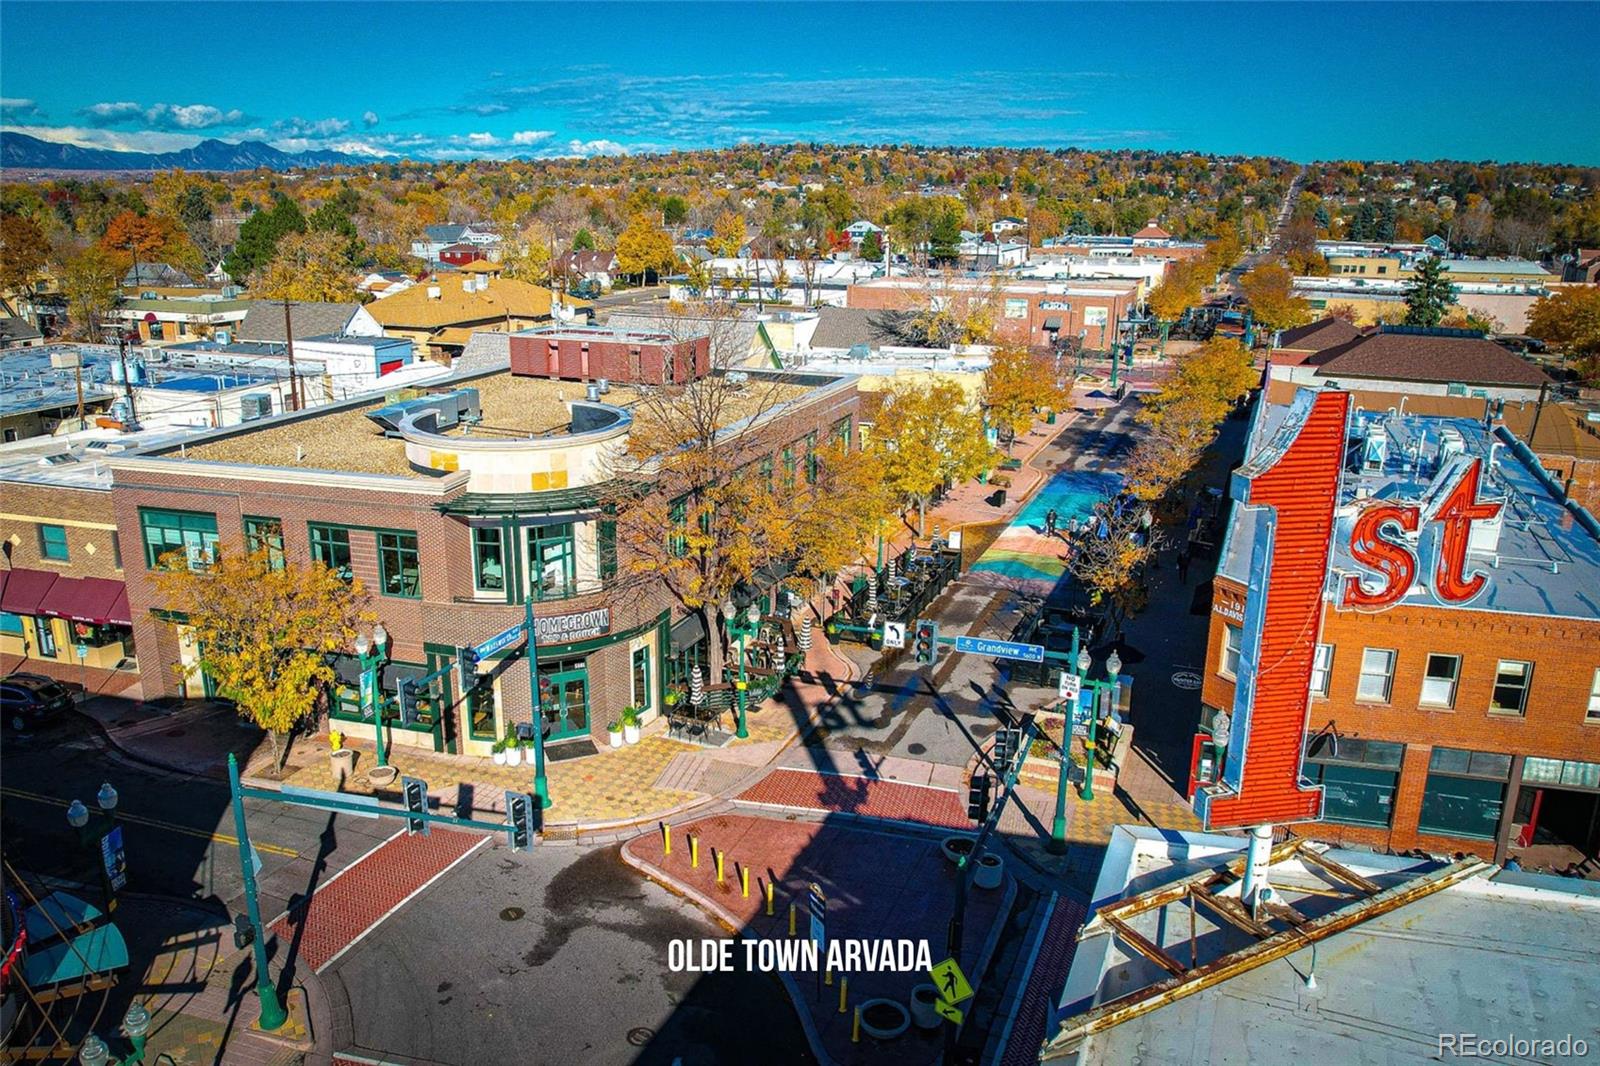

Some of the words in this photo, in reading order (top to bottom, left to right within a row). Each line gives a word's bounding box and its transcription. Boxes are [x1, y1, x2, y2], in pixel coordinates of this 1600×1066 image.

[885, 638, 901, 646] ONLY
[977, 641, 1020, 656] Grandview
[1066, 674, 1076, 682] NO
